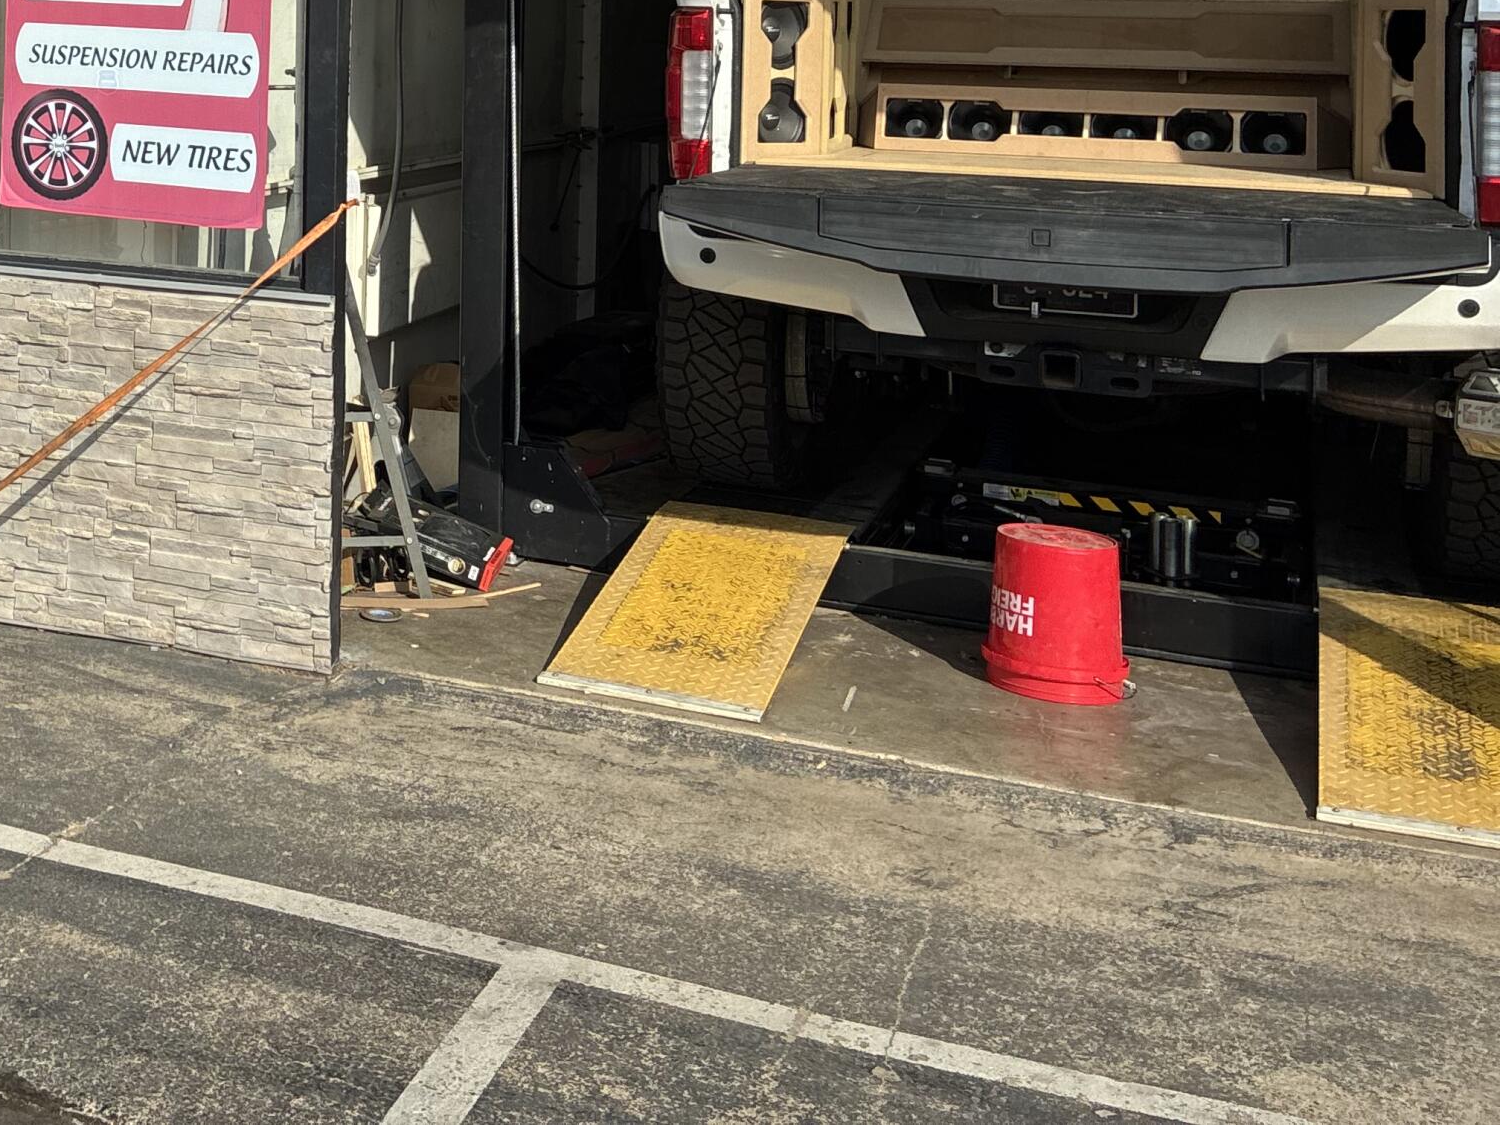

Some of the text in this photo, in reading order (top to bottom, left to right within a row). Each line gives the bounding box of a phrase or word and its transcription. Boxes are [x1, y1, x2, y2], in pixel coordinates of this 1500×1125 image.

[28, 43, 253, 76] SUSPENSION REPAIRS
[121, 140, 253, 173] NEW TIRES
